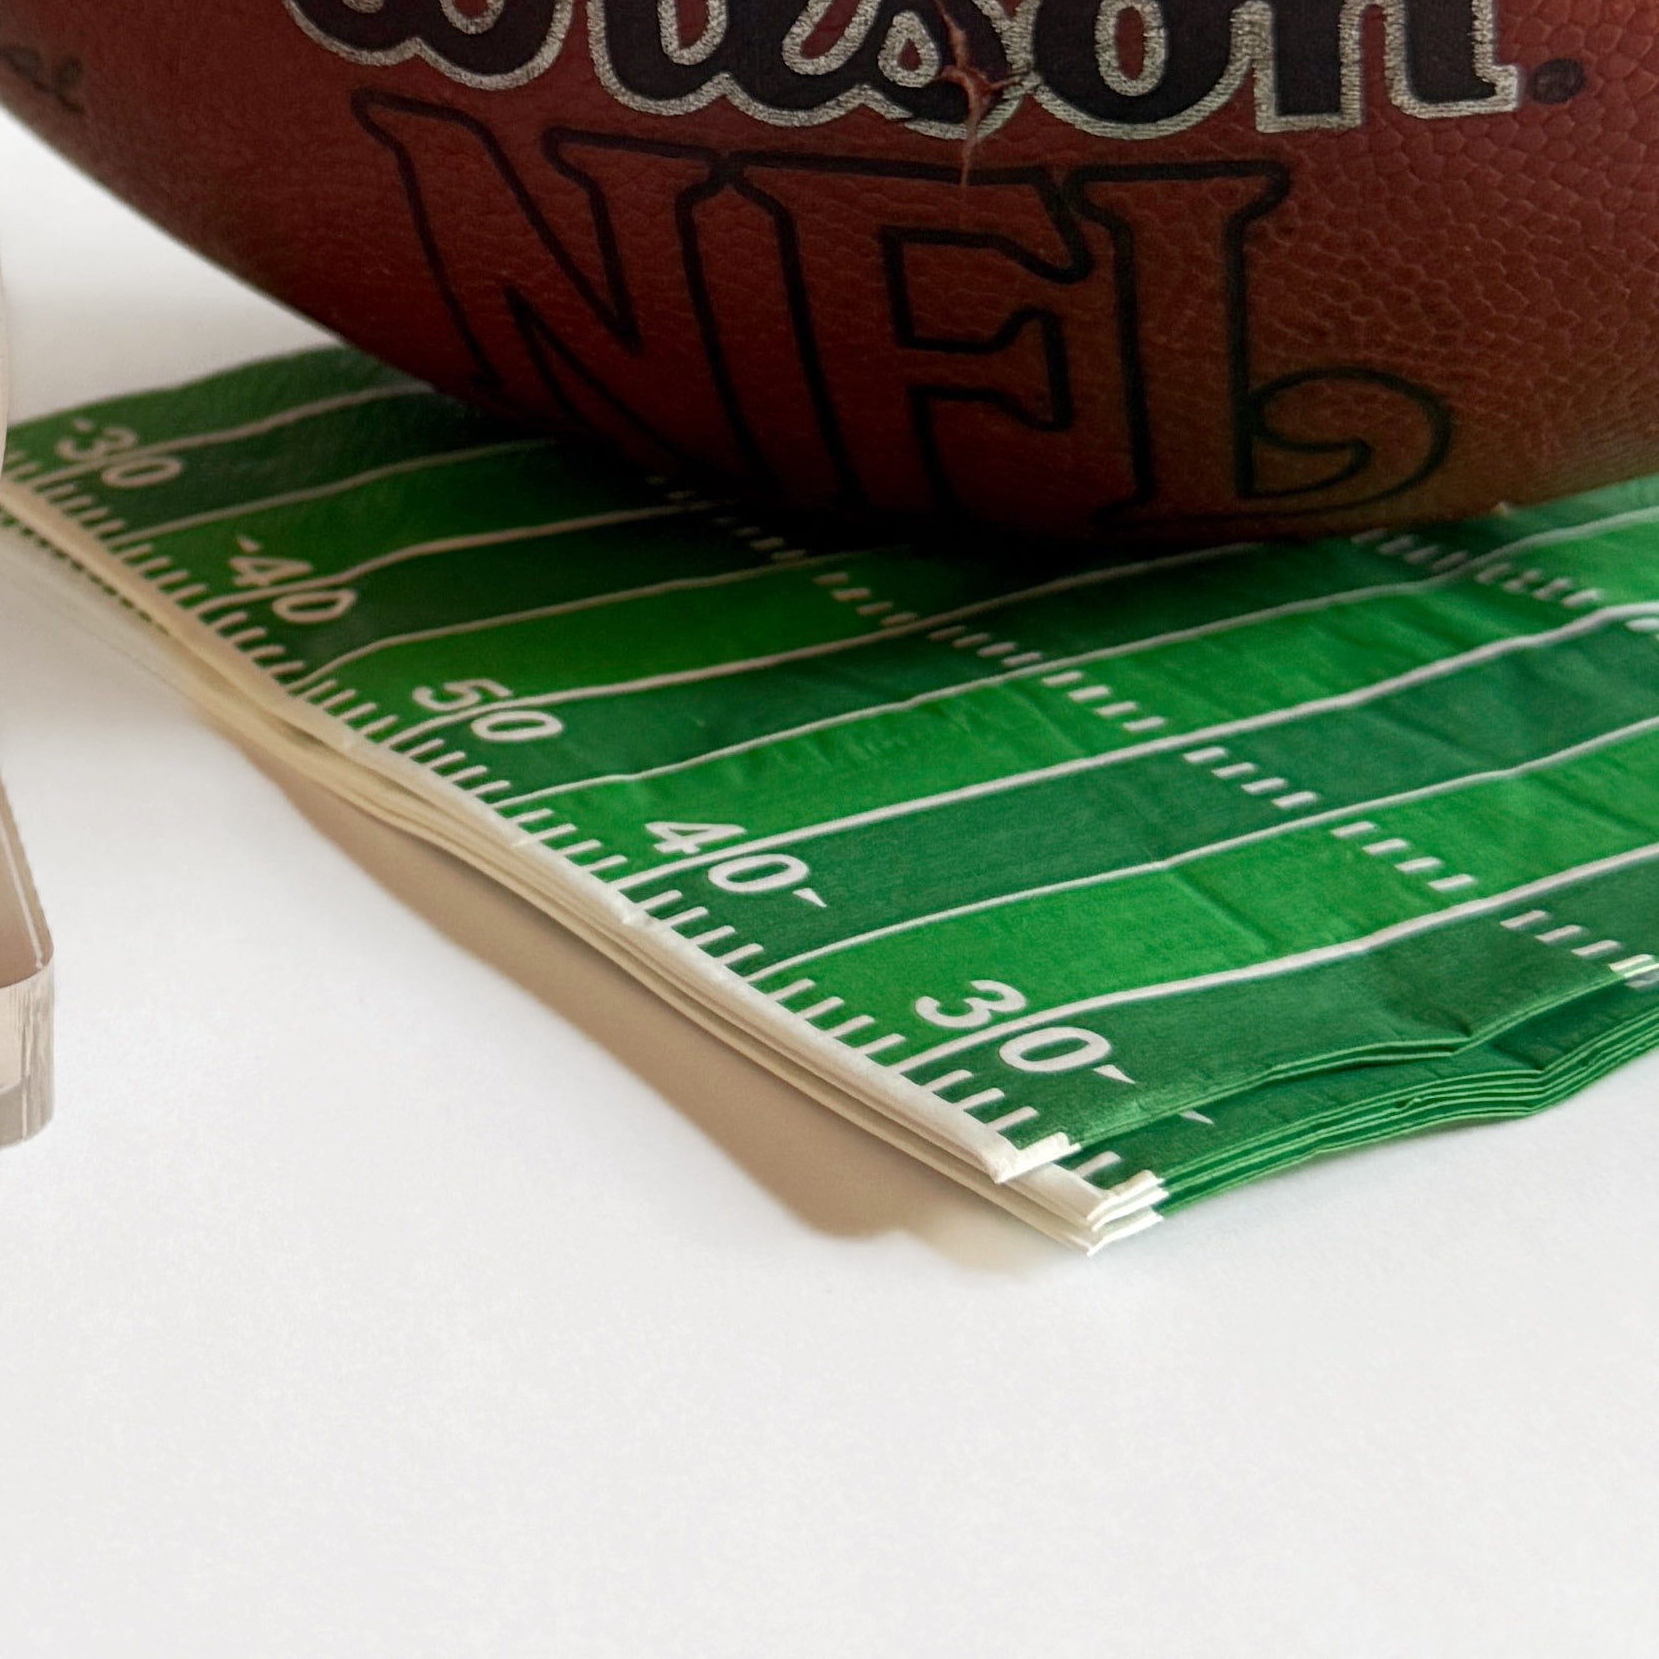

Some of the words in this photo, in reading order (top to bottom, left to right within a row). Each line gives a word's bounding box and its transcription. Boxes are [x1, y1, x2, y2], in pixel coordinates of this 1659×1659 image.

[351, 90, 1453, 539] NFL
[55, 425, 184, 488] 30
[227, 555, 358, 624] 40
[411, 678, 564, 742] 50
[644, 820, 811, 893] 40
[914, 979, 1113, 1074] 30
